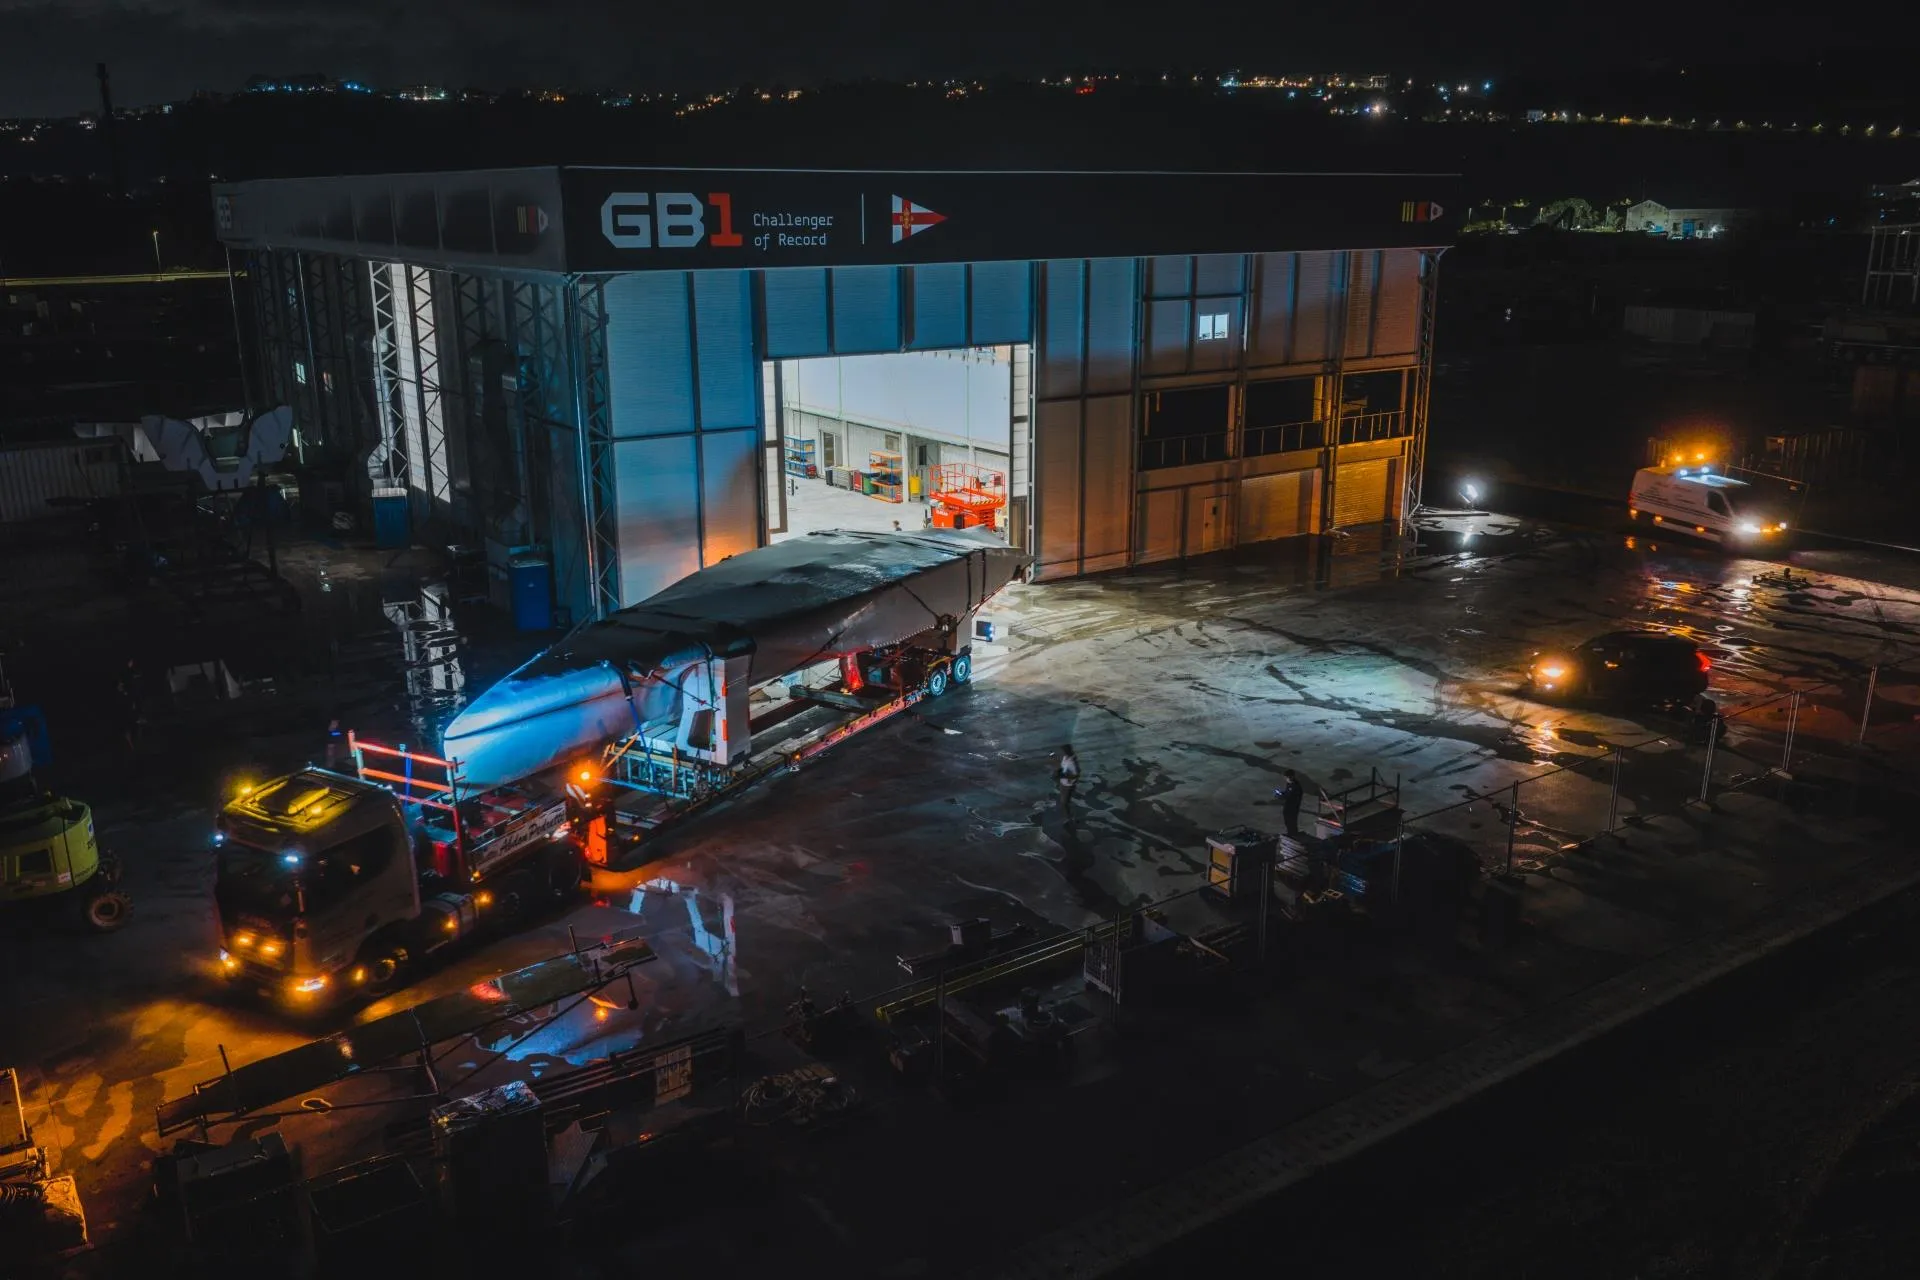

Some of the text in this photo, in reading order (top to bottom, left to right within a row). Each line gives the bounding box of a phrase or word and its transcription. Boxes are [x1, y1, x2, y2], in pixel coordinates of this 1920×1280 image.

[600, 192, 743, 248] GB1
[753, 213, 834, 230] Challenger
[754, 232, 827, 251] of Record
